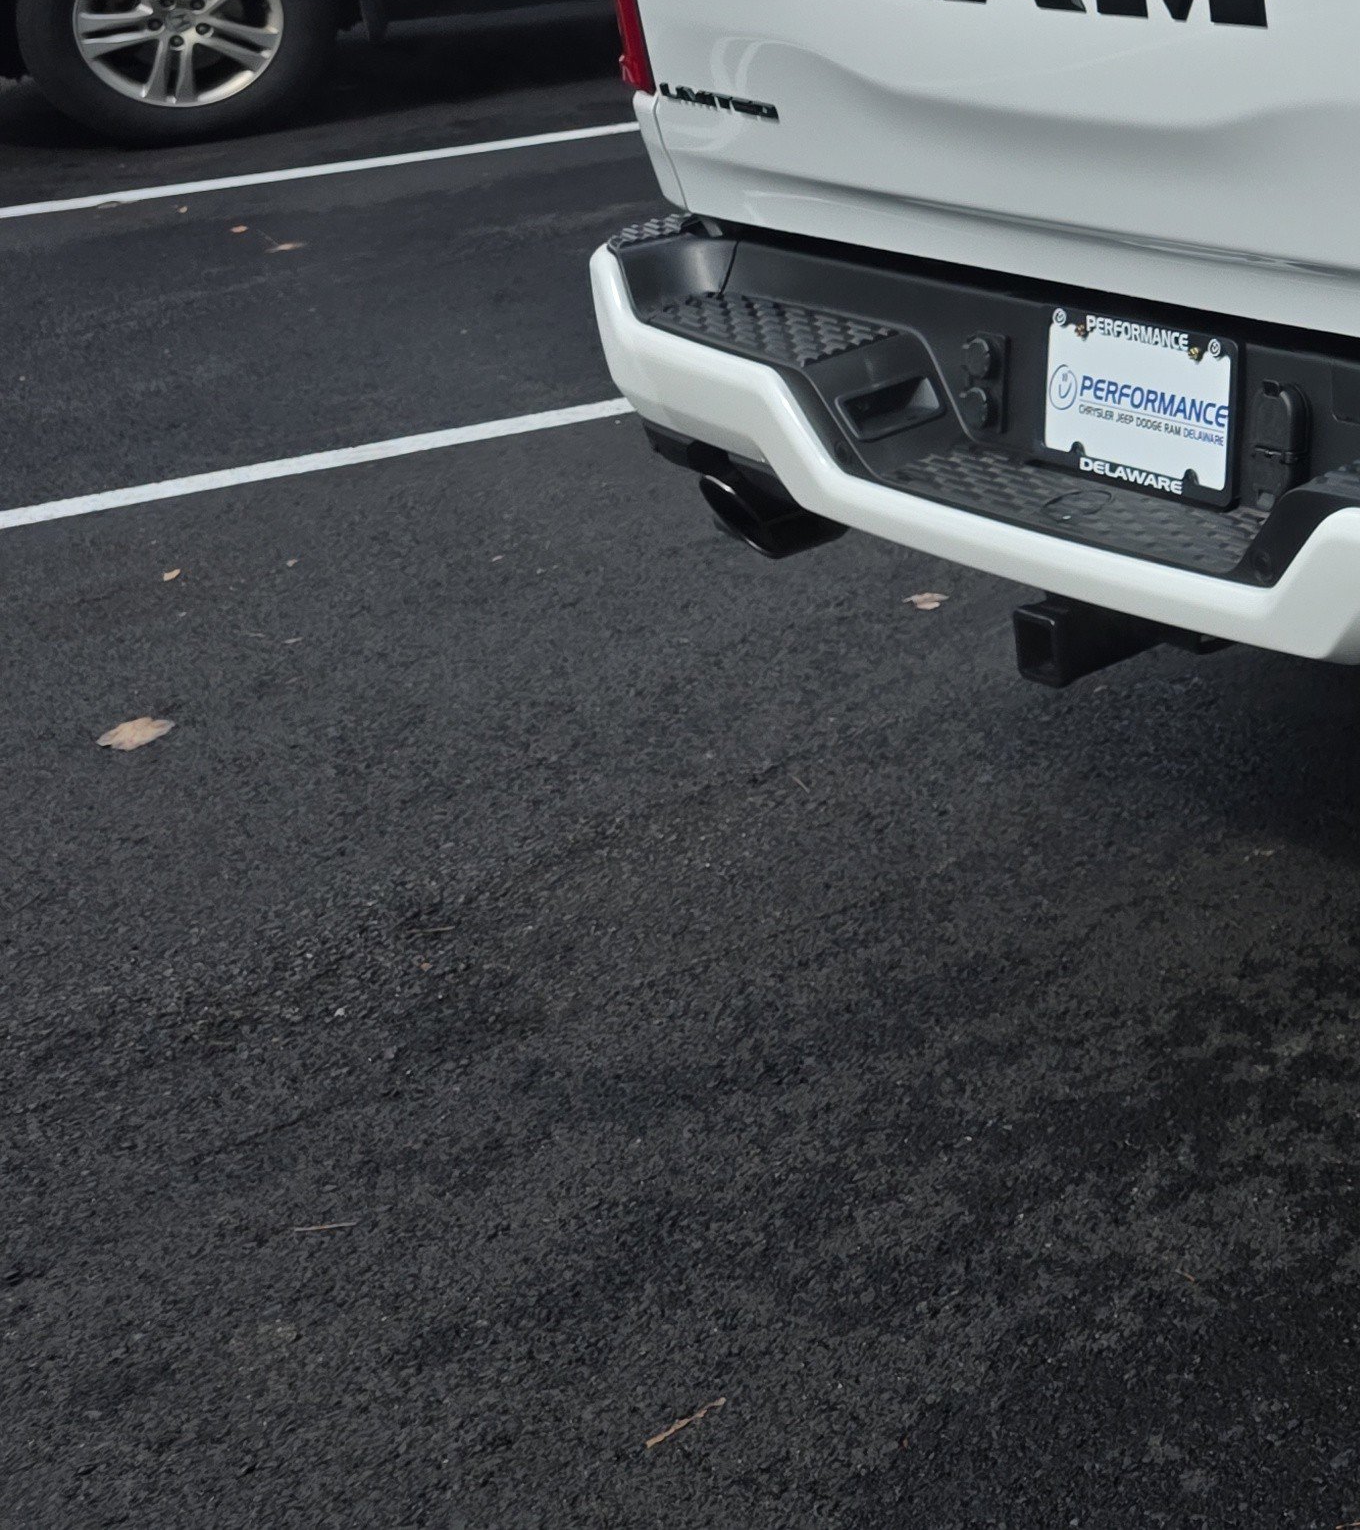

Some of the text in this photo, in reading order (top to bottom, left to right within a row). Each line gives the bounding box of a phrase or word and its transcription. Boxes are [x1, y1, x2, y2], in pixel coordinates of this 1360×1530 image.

[1085, 314, 1189, 352] PERFORMANCE
[1079, 375, 1229, 428] PERFORMANCE
[1078, 404, 1225, 447] CHRYSLER JEEP DODGE RAM DELAWARE
[1079, 456, 1184, 496] DELAWARE
